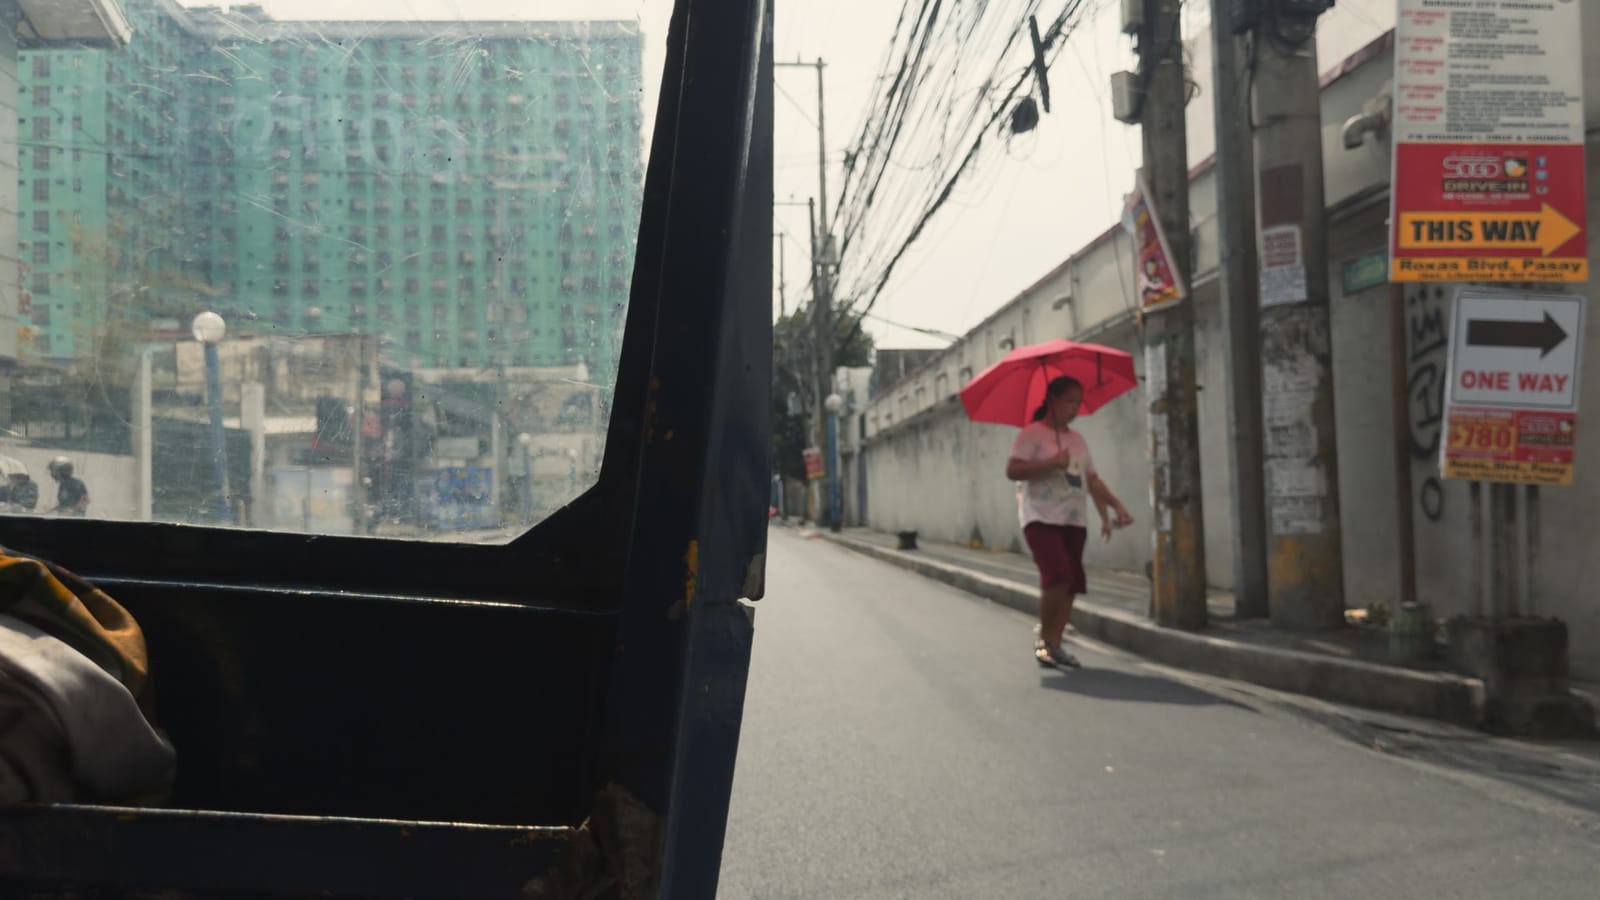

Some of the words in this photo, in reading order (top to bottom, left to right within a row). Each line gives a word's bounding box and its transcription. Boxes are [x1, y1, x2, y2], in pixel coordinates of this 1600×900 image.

[1444, 181, 1528, 193] DRIVE-IN
[1410, 220, 1473, 242] THIS
[1480, 220, 1541, 242] WAY
[1400, 258, 1459, 271] Roxas
[1522, 258, 1582, 273] Pasay
[1460, 370, 1510, 391] ONE
[1518, 373, 1569, 394] WAY
